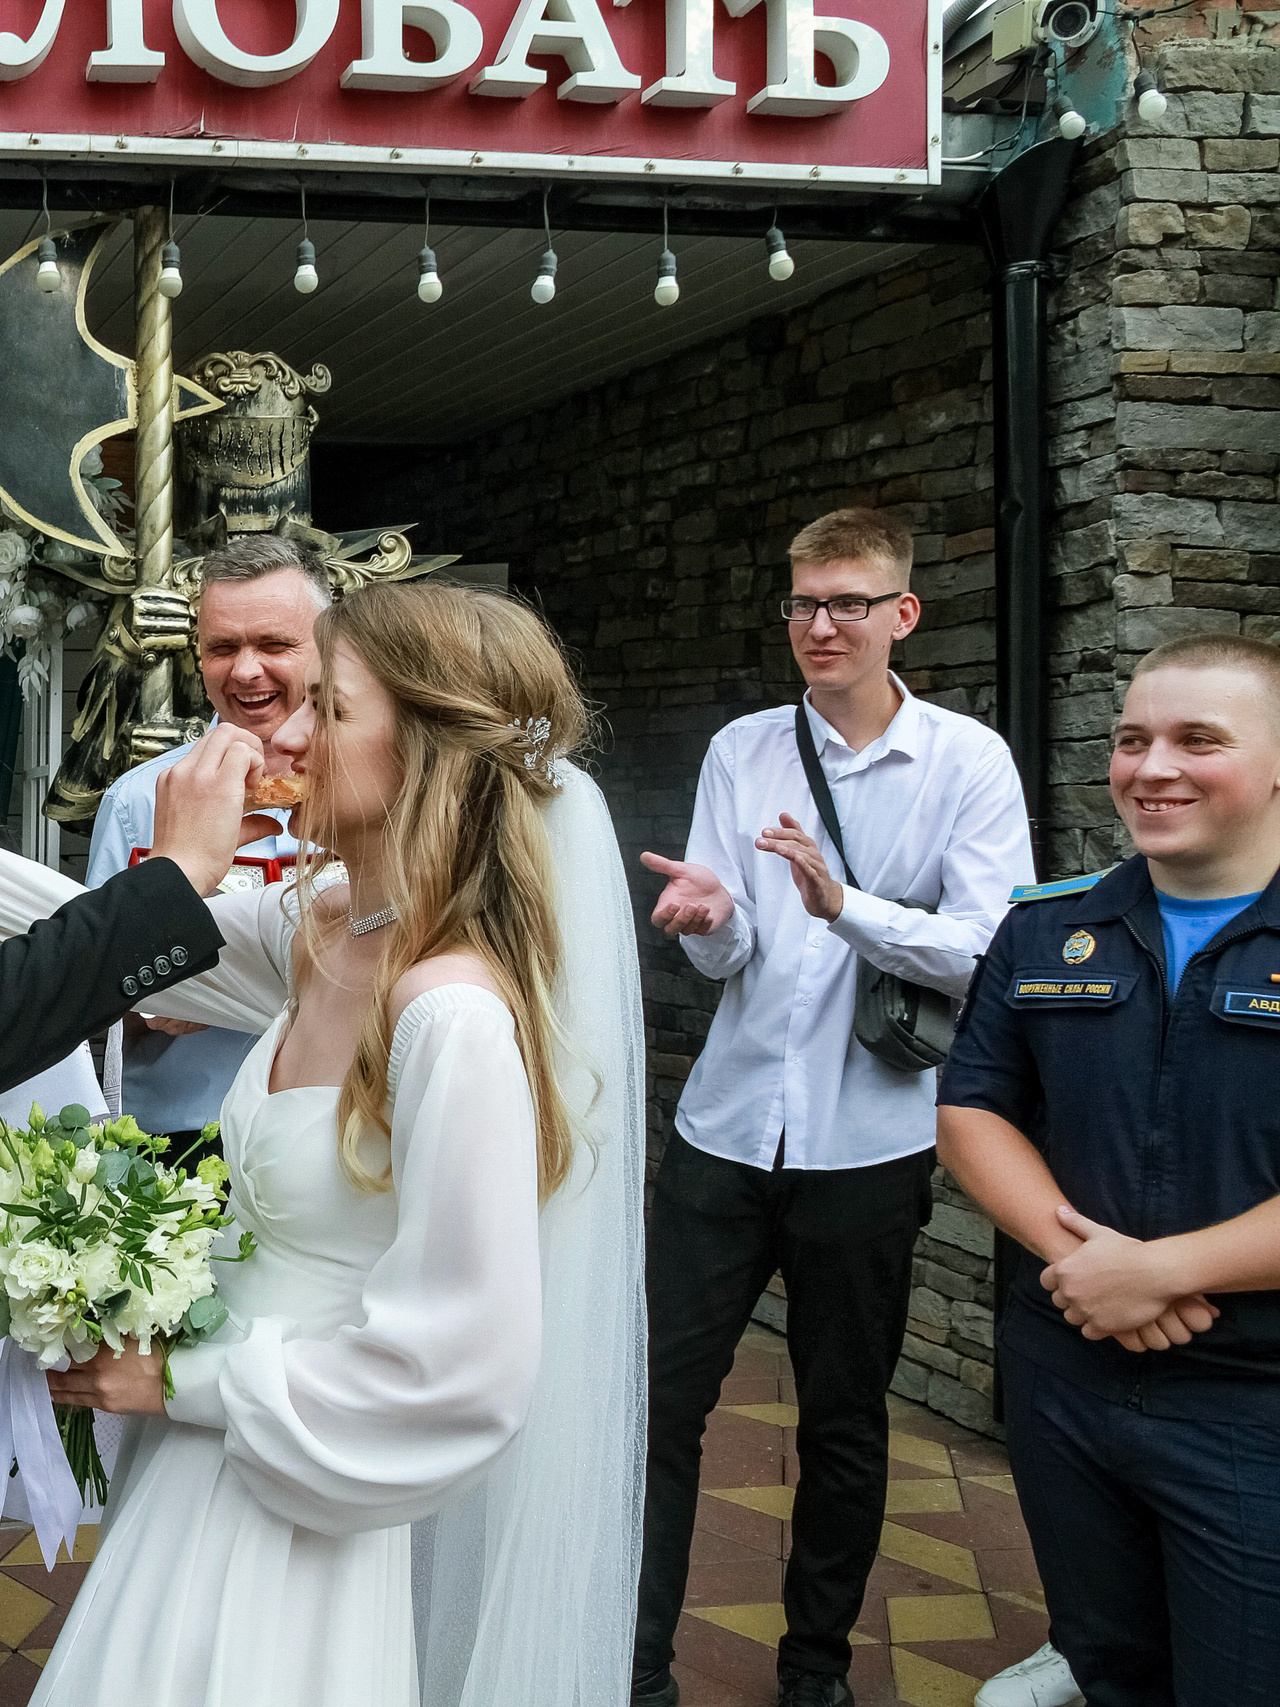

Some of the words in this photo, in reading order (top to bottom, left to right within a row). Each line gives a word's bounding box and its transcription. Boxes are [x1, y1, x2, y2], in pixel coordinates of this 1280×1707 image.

[1018, 983, 1064, 994] ВООРУЖЕННЫЕ
[1064, 983, 1084, 994] СИЛЫ
[1084, 983, 1112, 994] РОССИИ
[1248, 998, 1280, 1012] АВД
